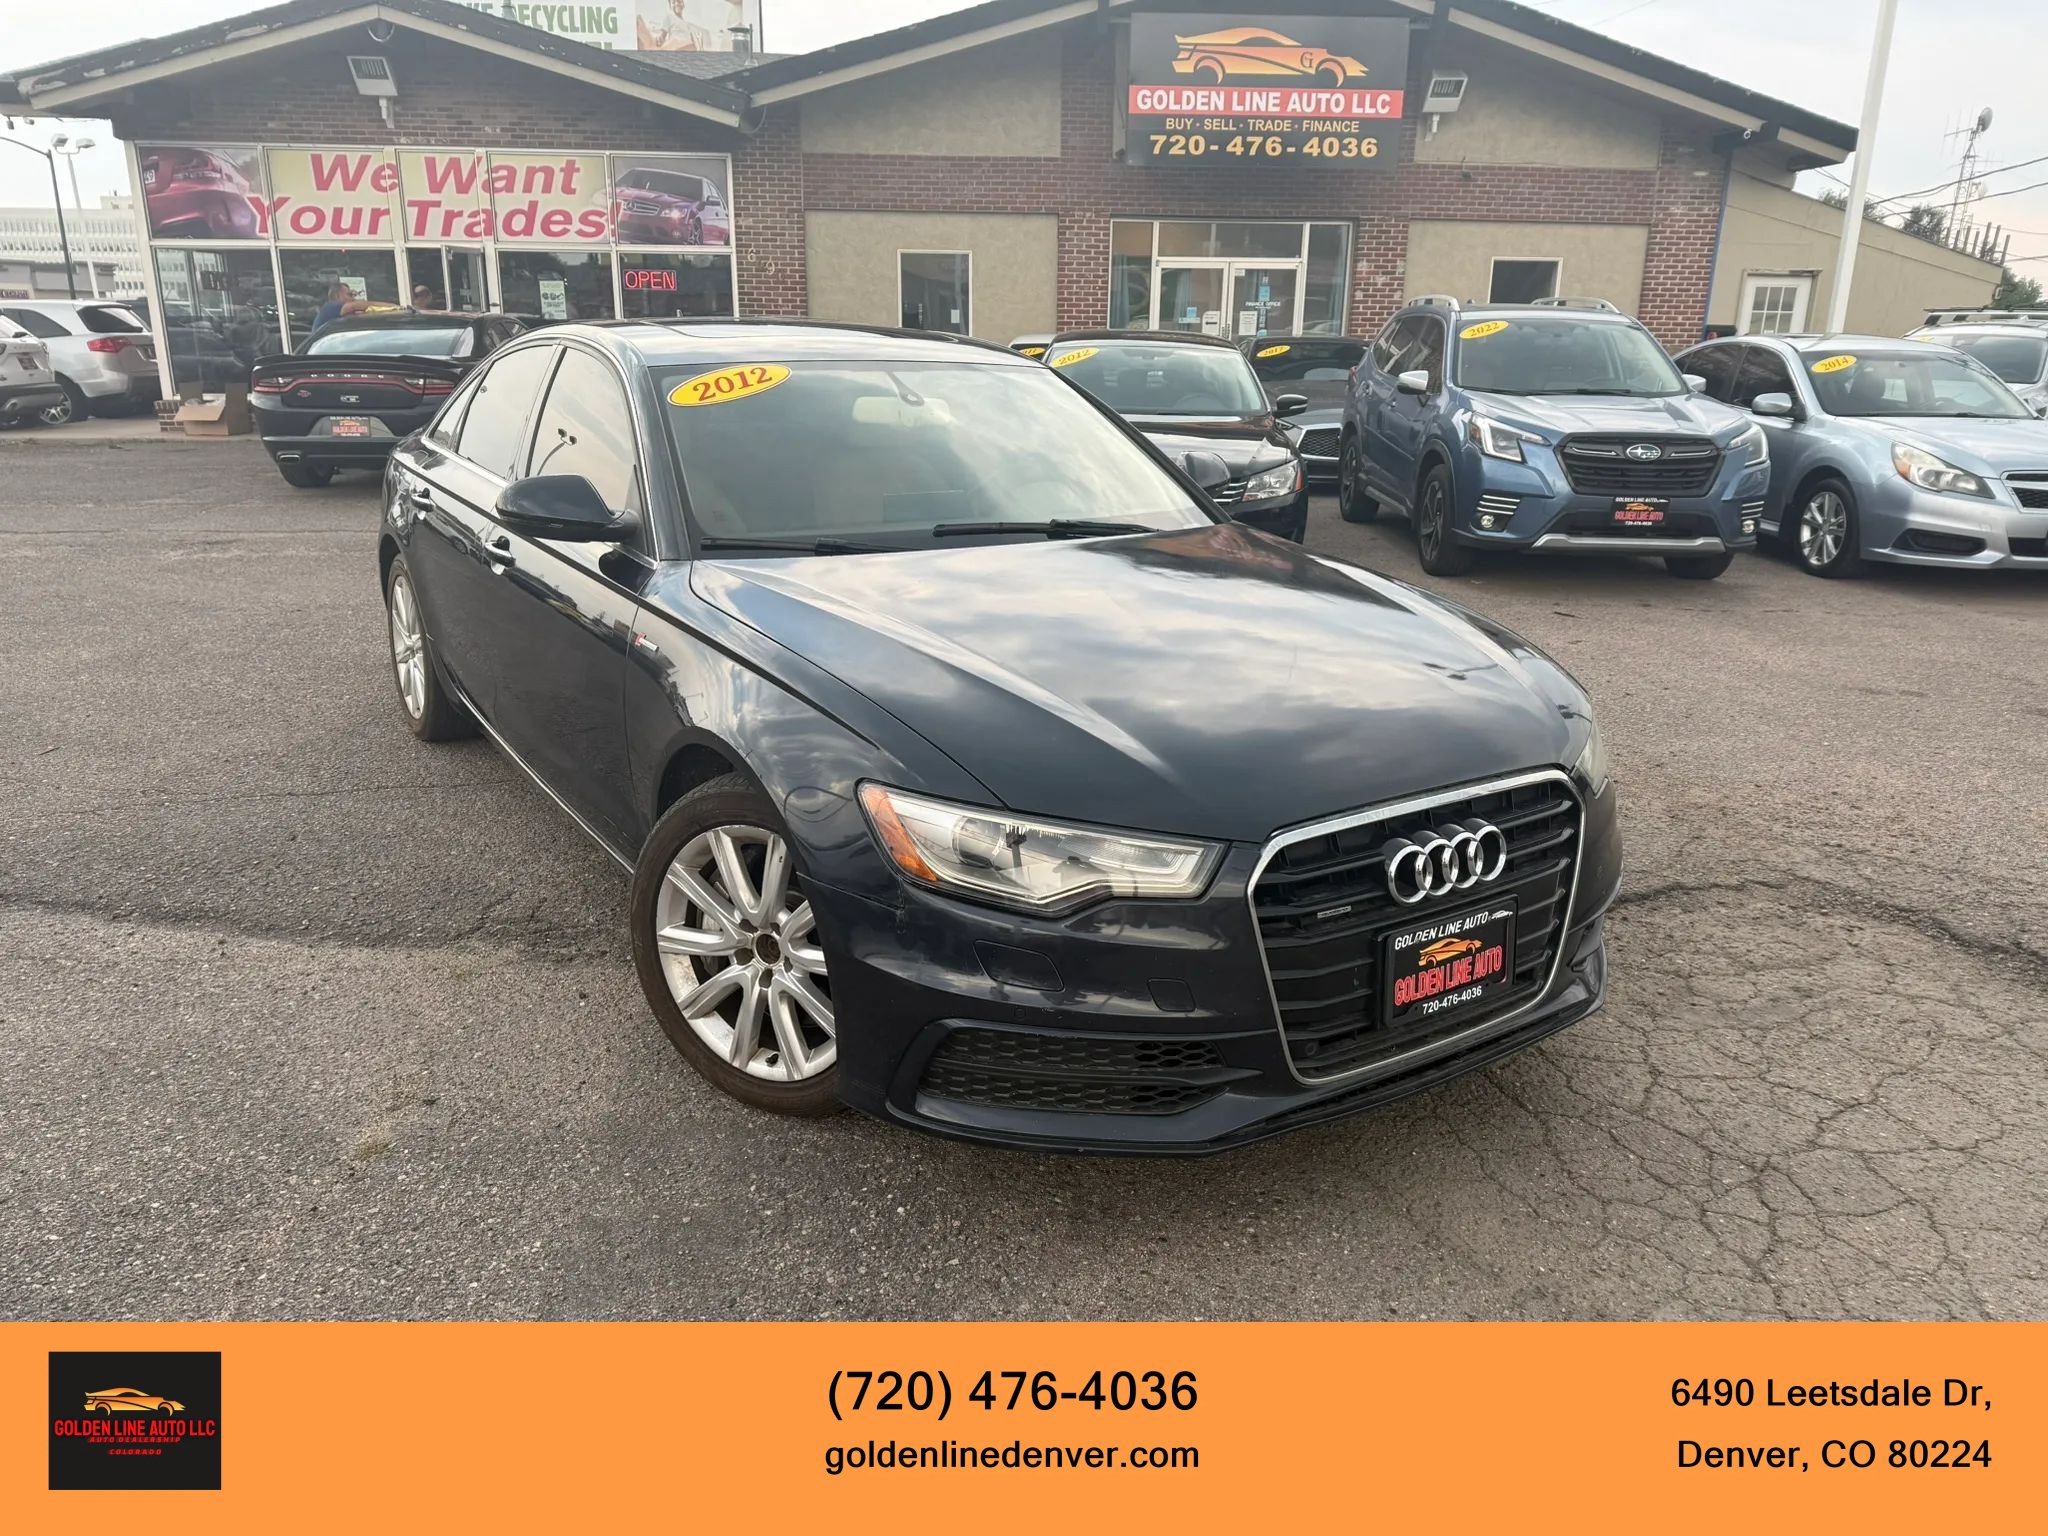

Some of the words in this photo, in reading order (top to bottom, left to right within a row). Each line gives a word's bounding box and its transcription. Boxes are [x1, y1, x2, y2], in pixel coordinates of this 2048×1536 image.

[514, 4, 618, 34] ECYCLING
[1300, 52, 1313, 69] G
[1136, 89, 1226, 112] GOLDEN
[1231, 90, 1281, 113] LINE
[1287, 92, 1346, 114] AUTO
[1351, 93, 1391, 114] LLC
[1166, 118, 1194, 130] BUY
[1203, 118, 1237, 131] SELL
[1248, 119, 1292, 132] TRADE
[1302, 120, 1360, 133] FINANCE
[310, 153, 400, 194] We
[423, 156, 580, 195] Want
[247, 195, 392, 236] Your
[406, 199, 622, 240] Trades!
[625, 271, 675, 289] OPEN
[1470, 321, 1500, 337] 2022
[1058, 349, 1092, 365] 2012
[1820, 356, 1849, 371] 2014
[693, 366, 773, 402] 2012
[1394, 926, 1438, 951] GOLDEN
[1438, 919, 1463, 938] LINE
[1463, 911, 1489, 931] AUTO
[1394, 964, 1445, 1007] GOLDEN
[1445, 955, 1473, 990] LINE
[1472, 945, 1503, 980] AUTO
[1422, 985, 1483, 1015] 720-476-4036
